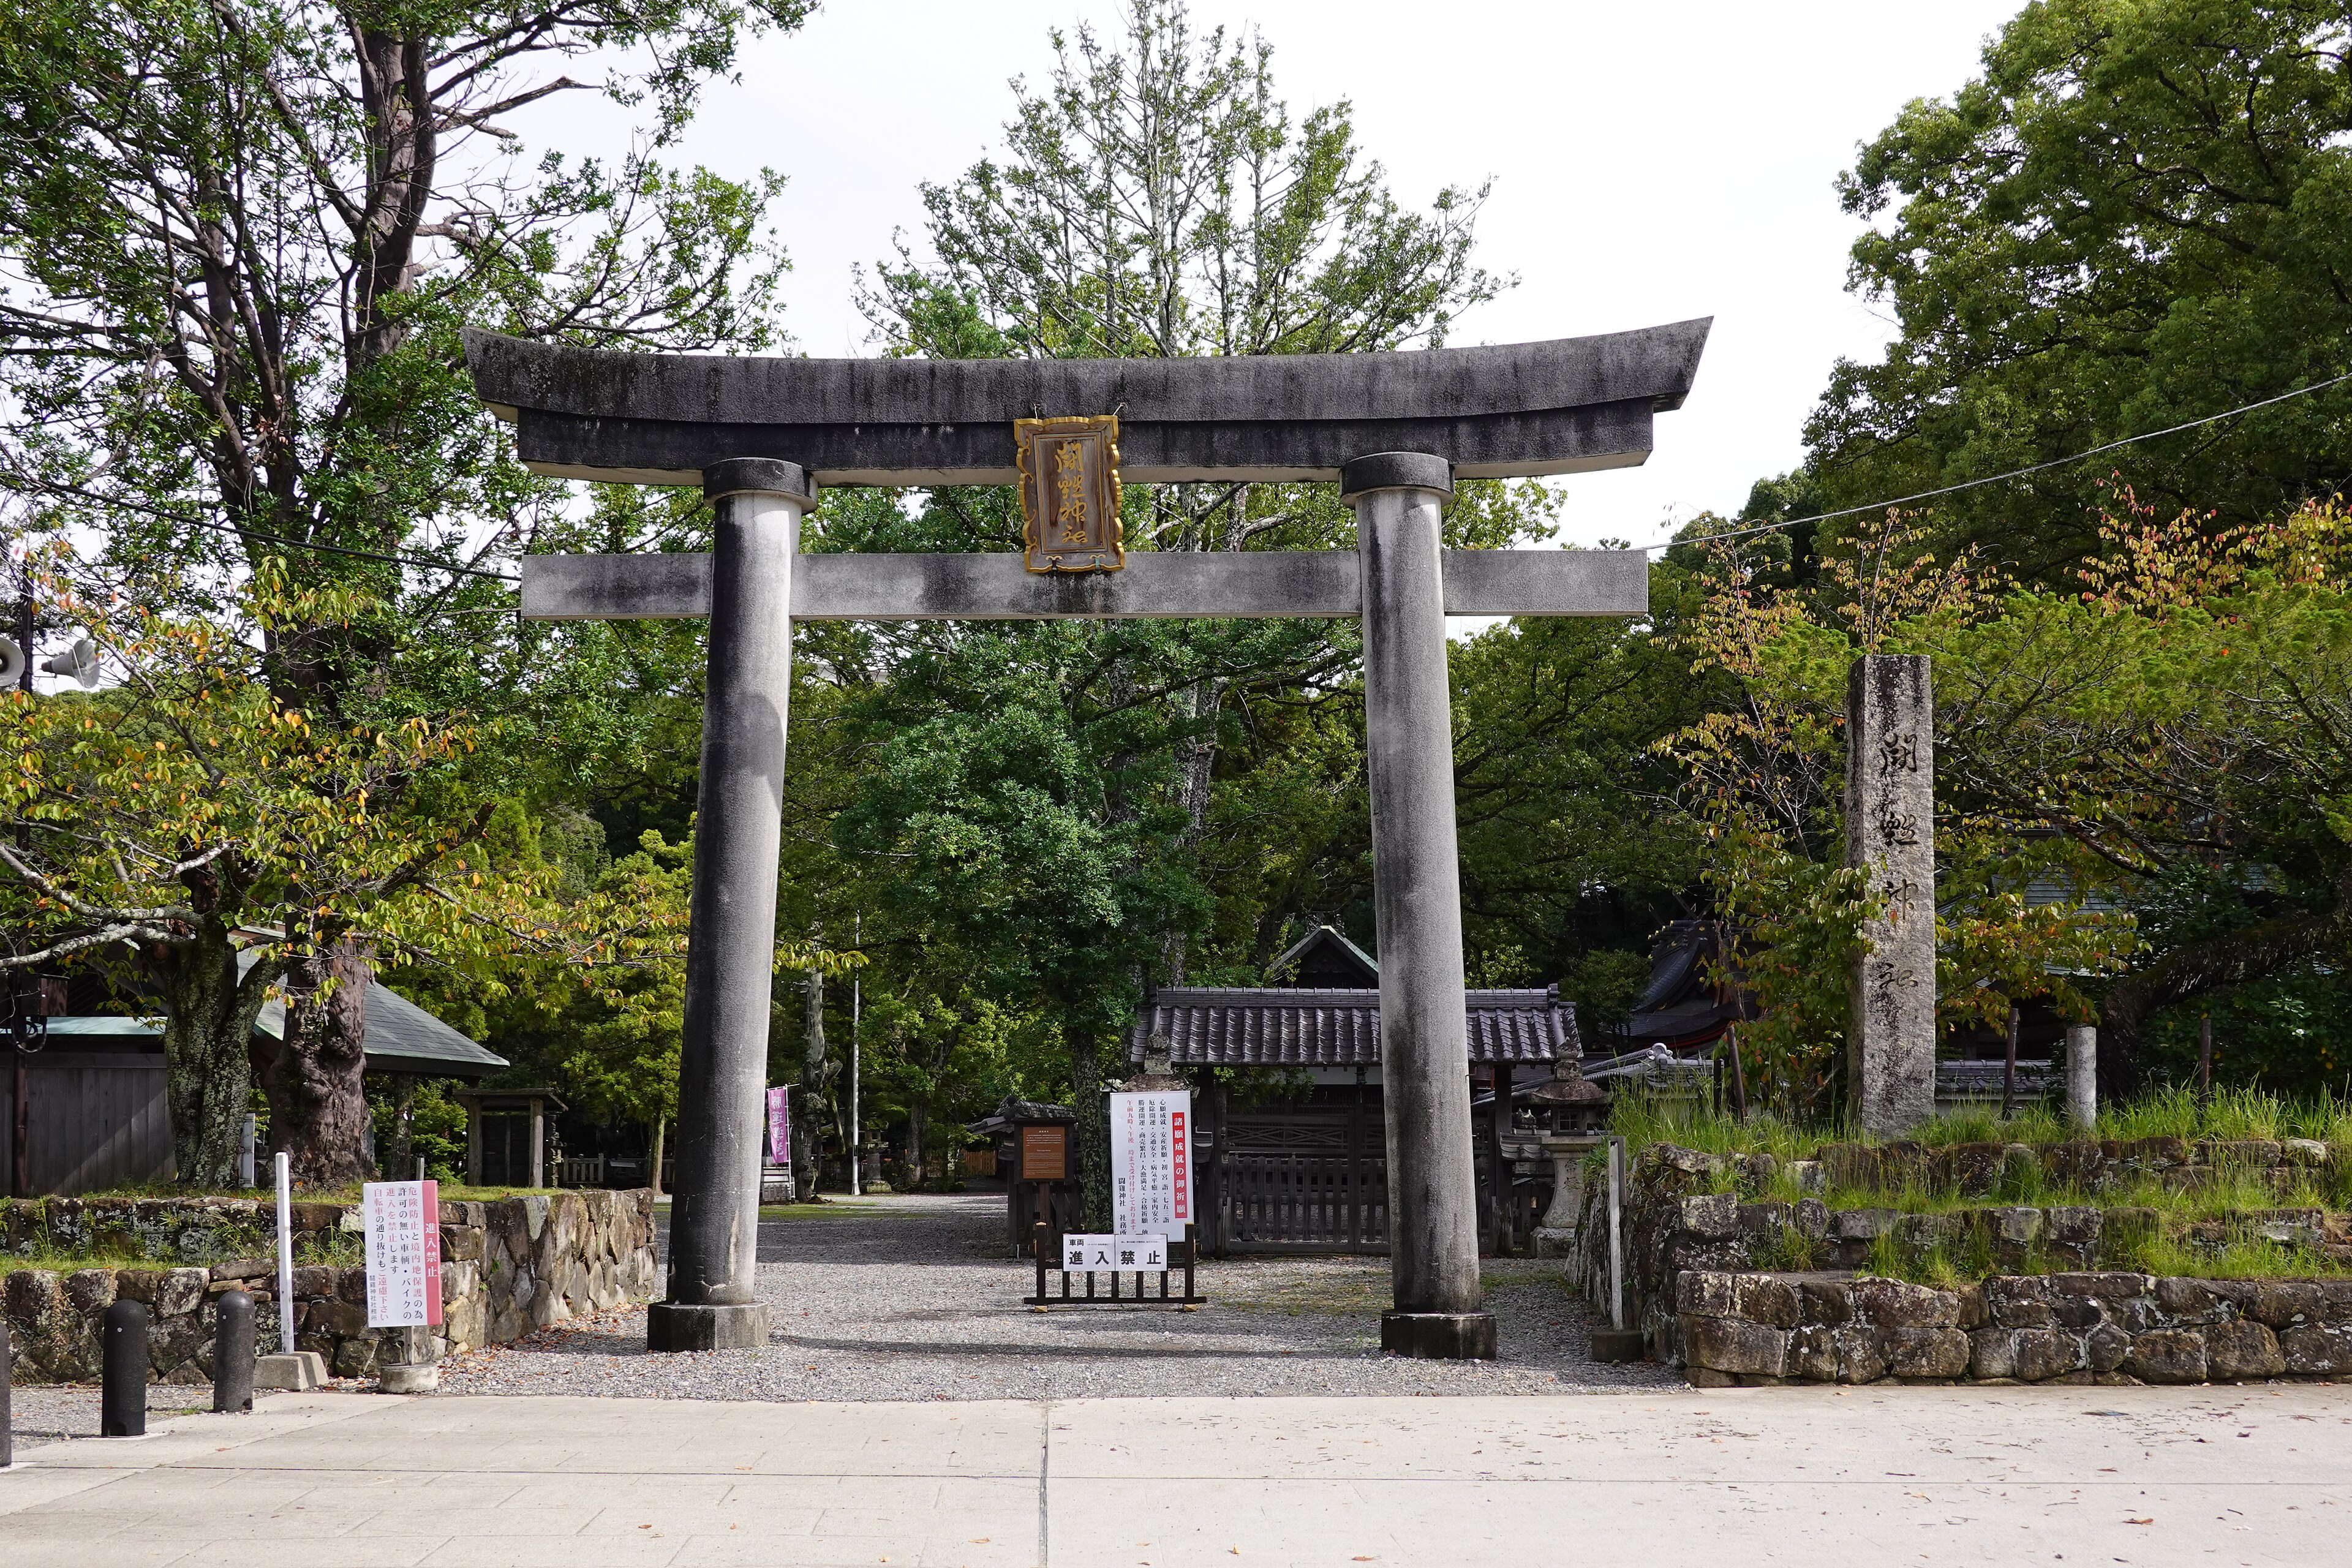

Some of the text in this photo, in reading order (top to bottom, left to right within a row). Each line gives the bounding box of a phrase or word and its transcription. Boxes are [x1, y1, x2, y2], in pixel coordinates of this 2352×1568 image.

[1174, 1117, 1186, 1213] 諸願成就の御祈願
[374, 1188, 388, 1321] 自転車の通り抜けもご遠慮下さい
[386, 1187, 399, 1275] 進入を禁止します
[409, 1186, 423, 1319] 危険防止と境内地保護の為
[426, 1223, 437, 1277] 進入禁止
